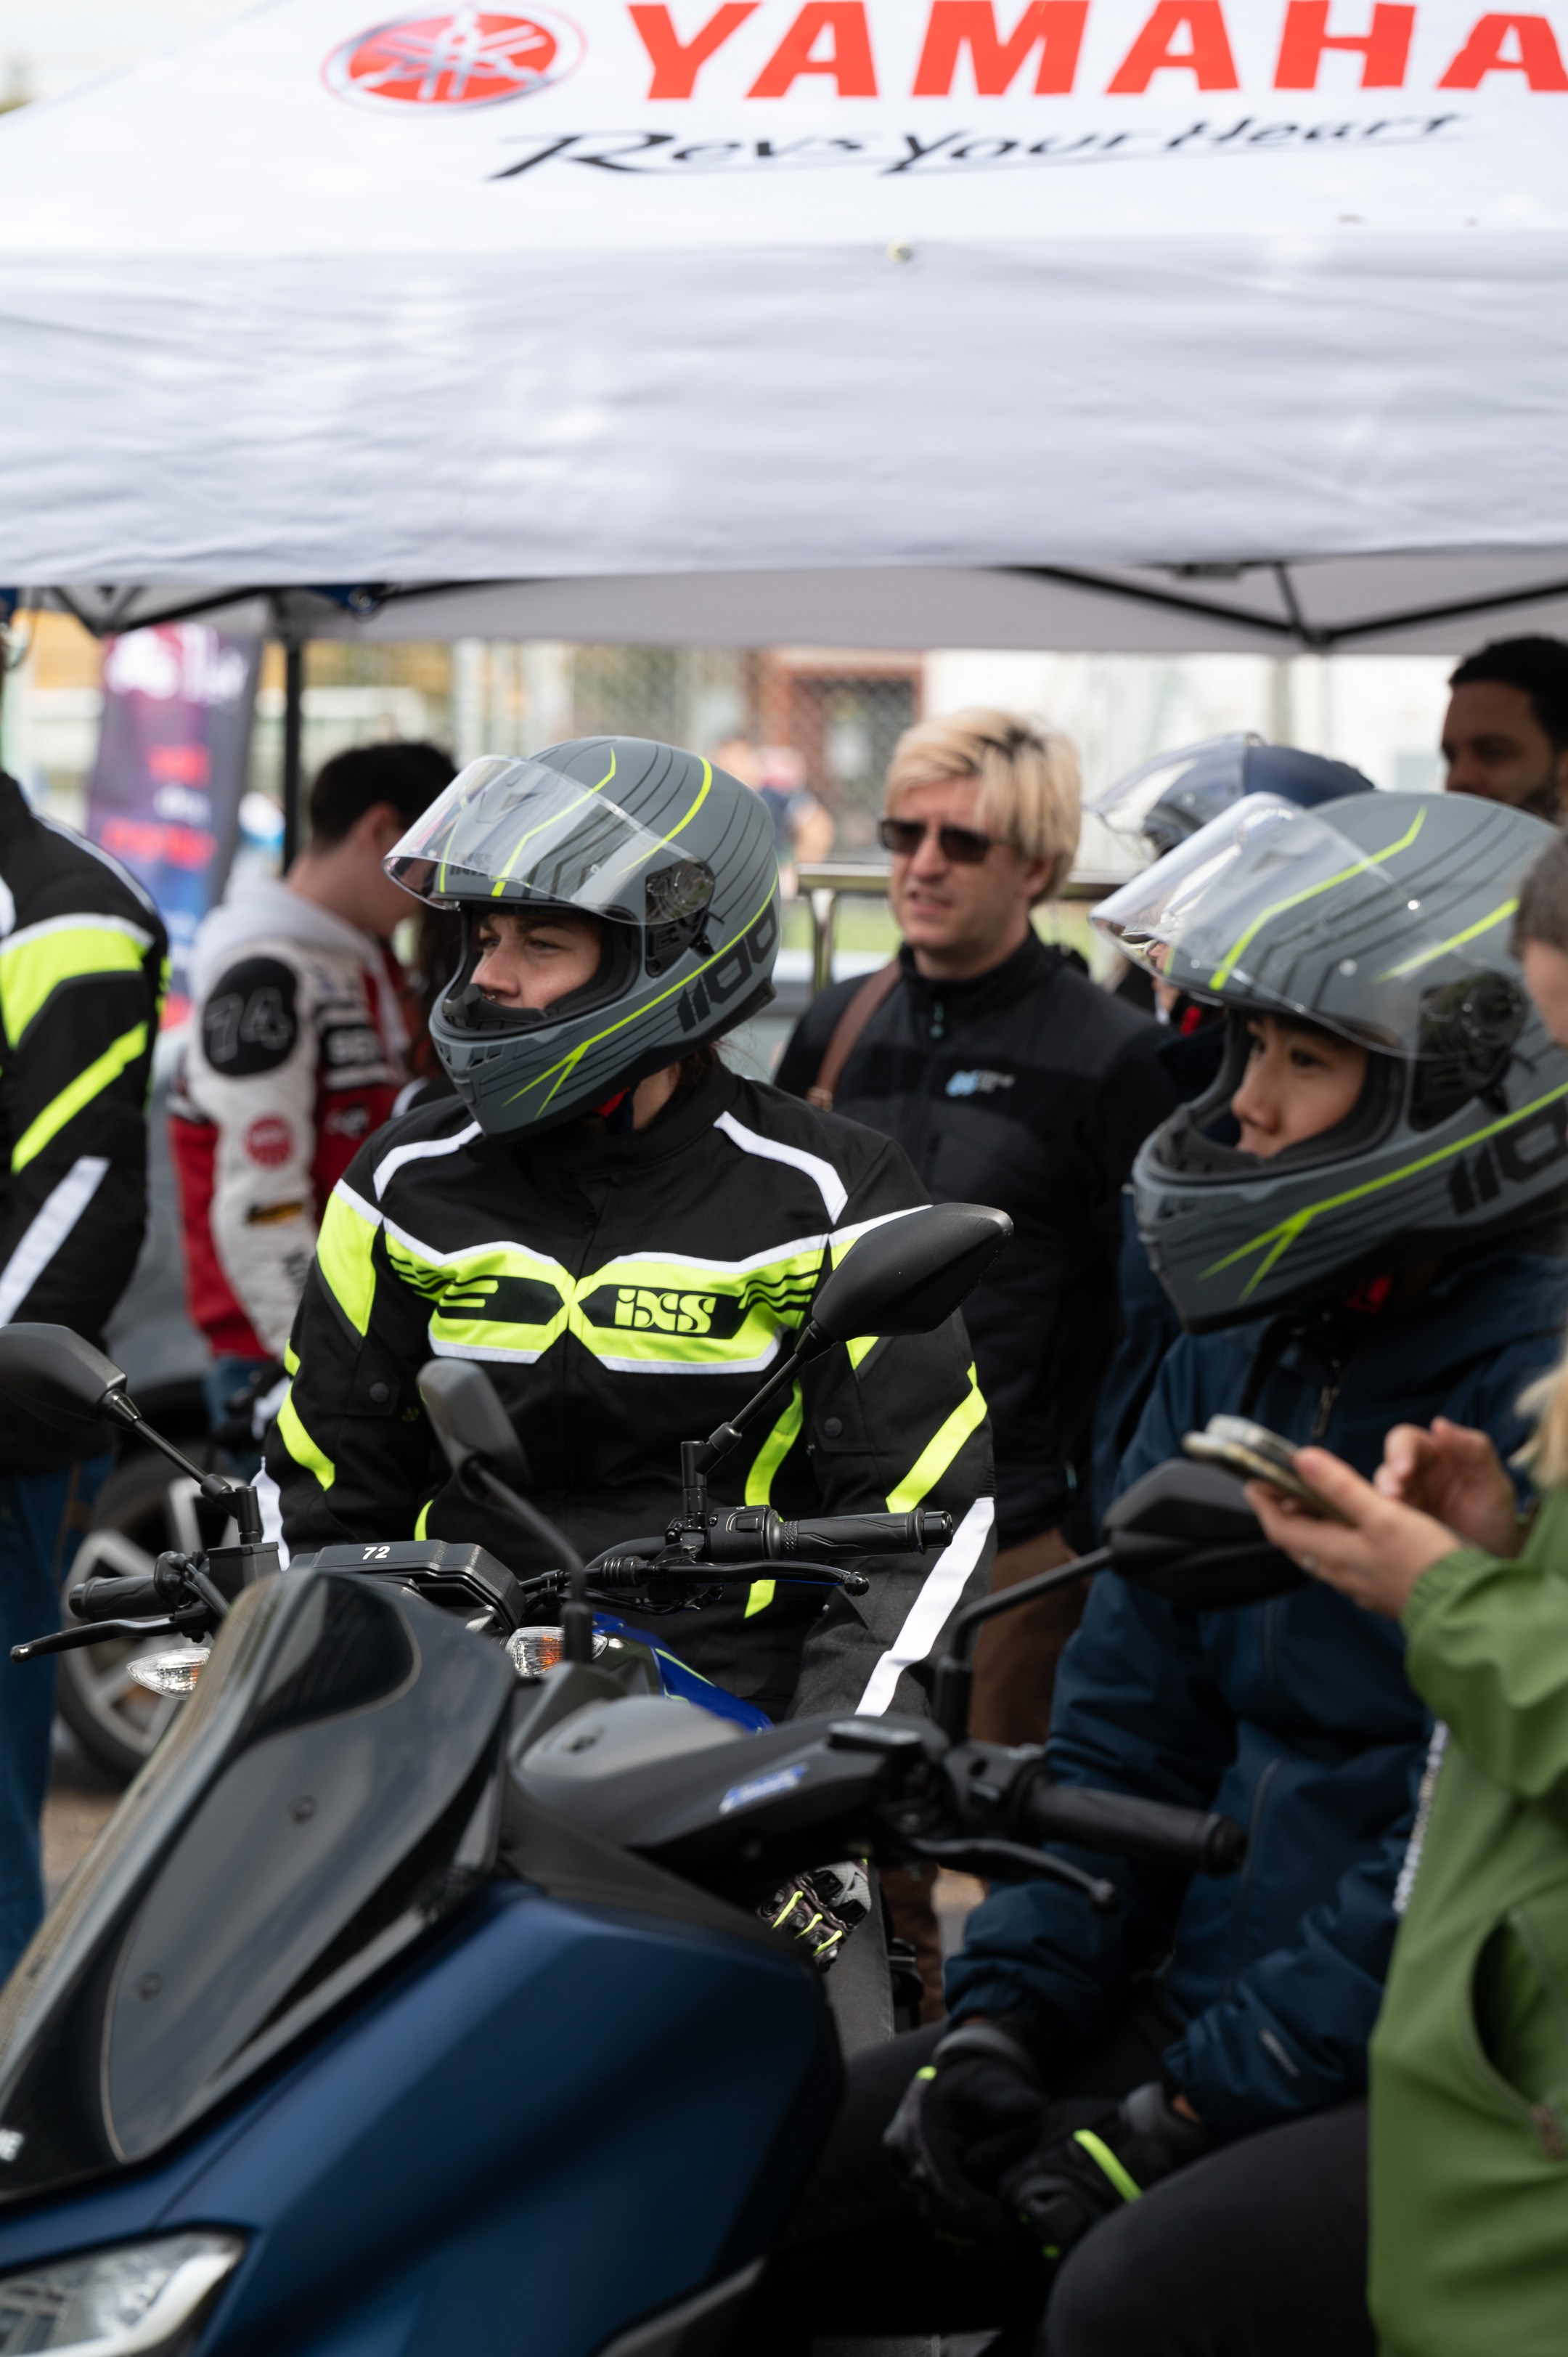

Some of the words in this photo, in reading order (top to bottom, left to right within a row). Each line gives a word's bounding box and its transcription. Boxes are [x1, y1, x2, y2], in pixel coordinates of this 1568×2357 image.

[627, 0, 1568, 99] YAMAHA
[484, 130, 865, 181] Revs
[1163, 113, 1468, 152] Heart
[362, 1545, 391, 1560] 72
